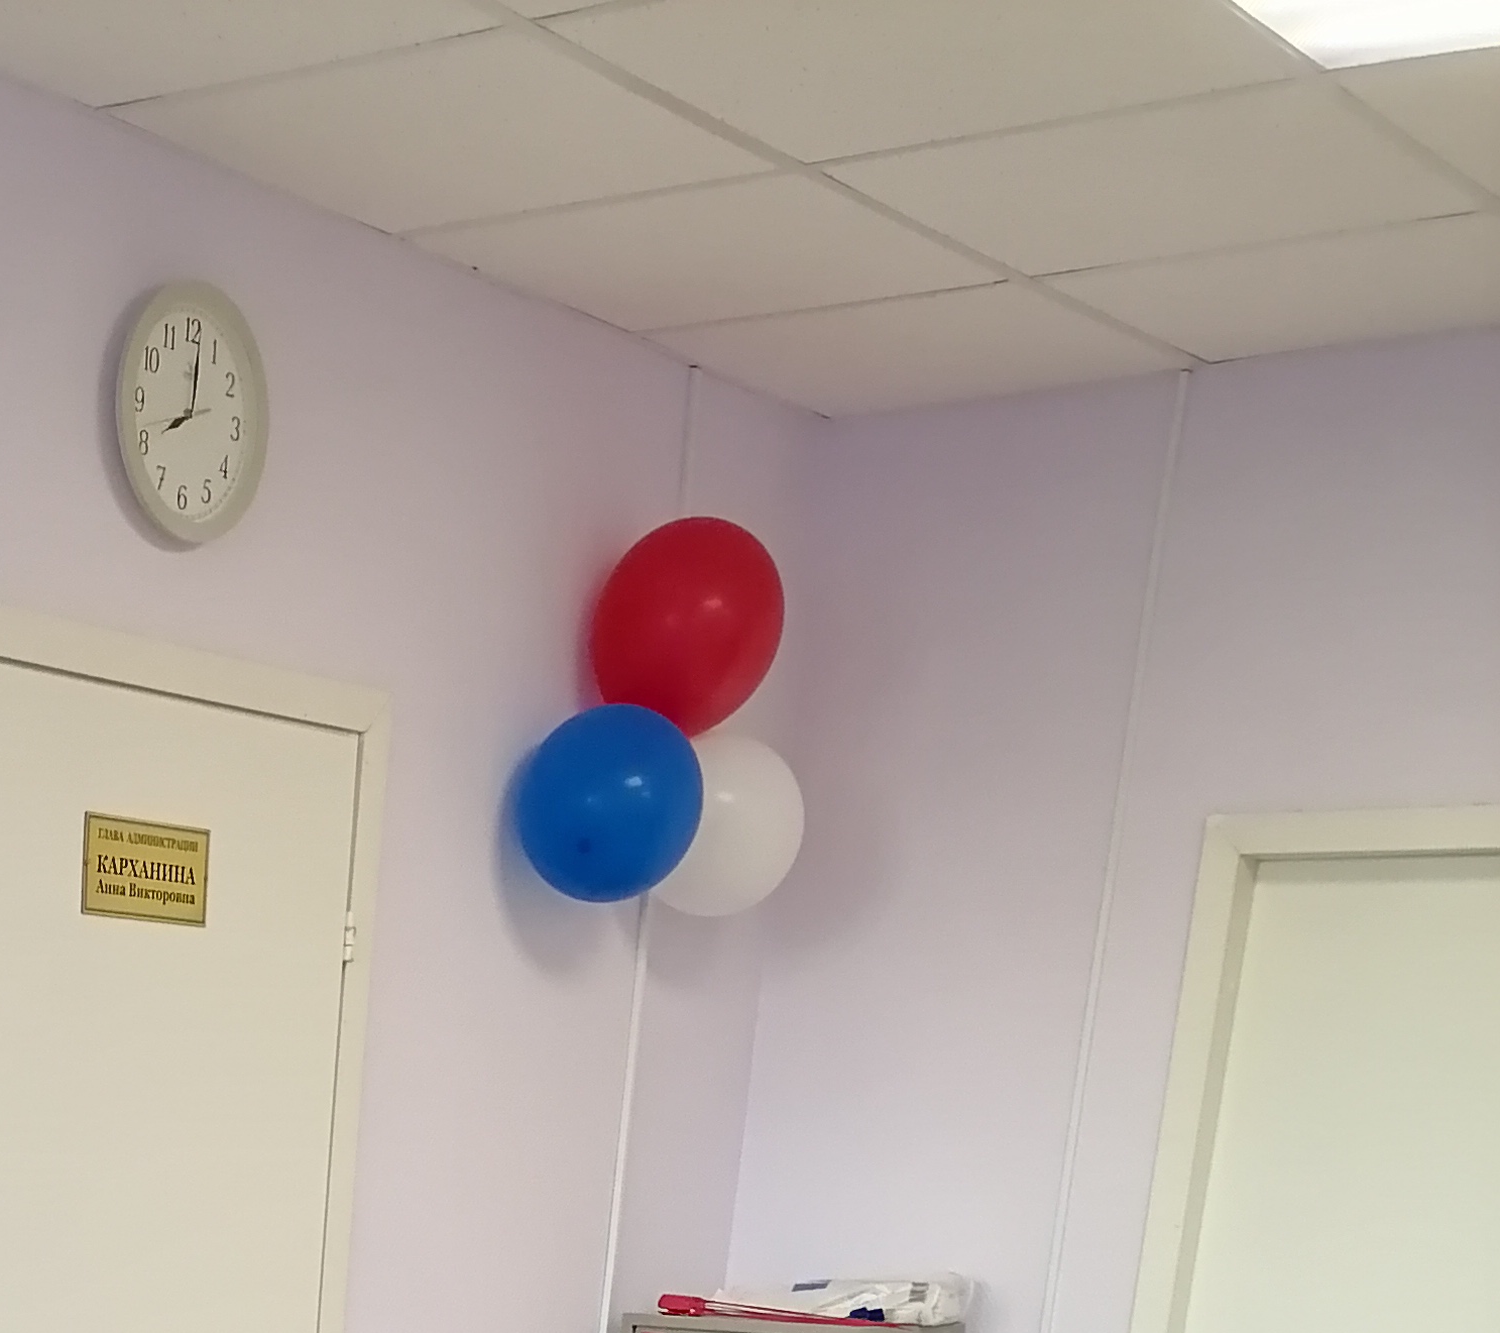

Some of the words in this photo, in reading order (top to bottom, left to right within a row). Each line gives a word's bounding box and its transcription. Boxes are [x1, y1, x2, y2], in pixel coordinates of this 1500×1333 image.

[163, 323, 176, 350] 11
[185, 317, 201, 344] 12
[144, 346, 160, 373] 10
[212, 339, 218, 365] 1
[225, 372, 235, 398] 2
[134, 386, 144, 412] 9
[230, 416, 241, 441] 3
[139, 429, 149, 455] 8
[157, 465, 166, 490] 7
[219, 455, 229, 479] 4
[177, 485, 187, 510] 6
[201, 479, 212, 504] 5
[98, 827, 124, 843] ГЛАВА
[126, 832, 198, 853] АДМИНИСТРАЦИИ
[97, 854, 196, 885] КАРХАНИНА
[96, 879, 126, 897] Анна
[128, 882, 196, 905] Викторовна
